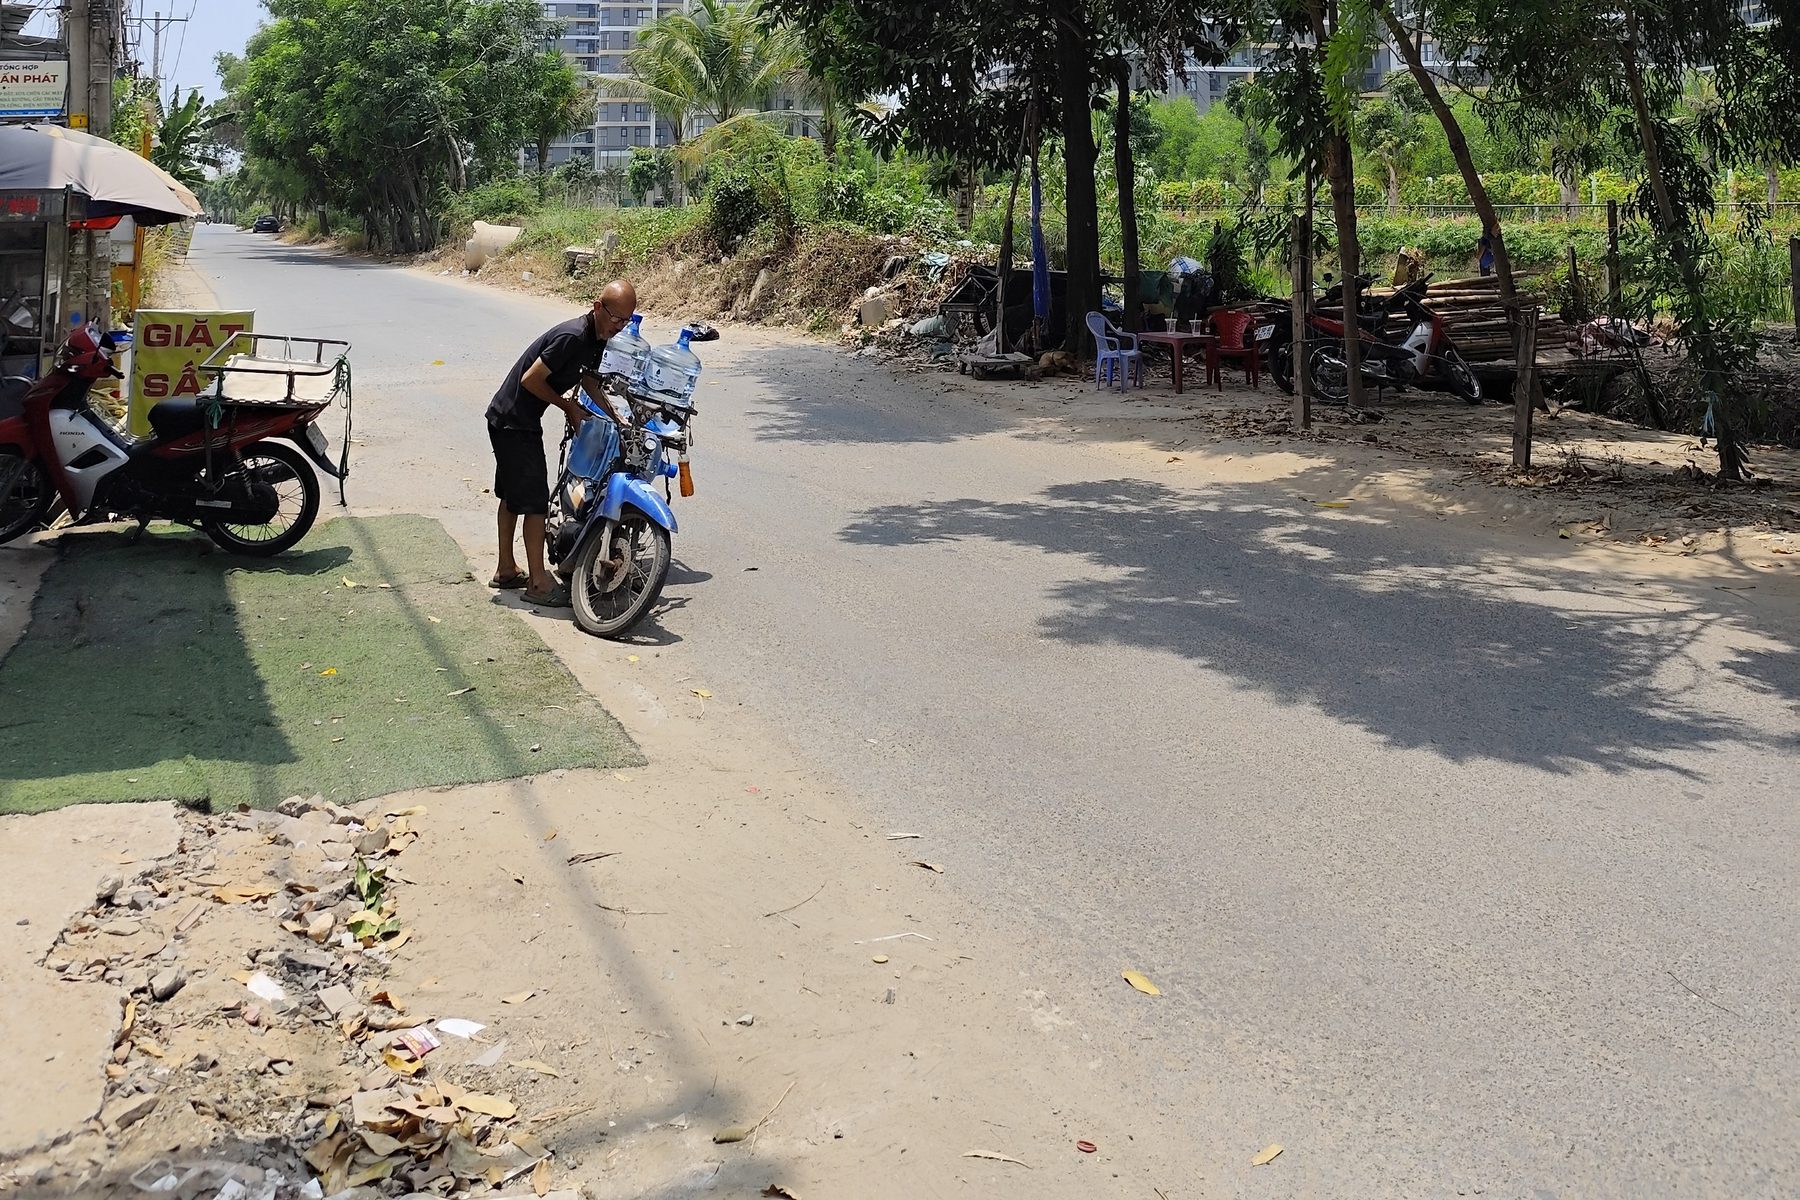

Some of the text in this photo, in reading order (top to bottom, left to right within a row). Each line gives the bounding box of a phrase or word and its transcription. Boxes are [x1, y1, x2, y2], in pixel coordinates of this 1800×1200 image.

[23, 72, 59, 83] PHÁT
[143, 318, 245, 353] GIẶT
[143, 360, 217, 397] SẤ
